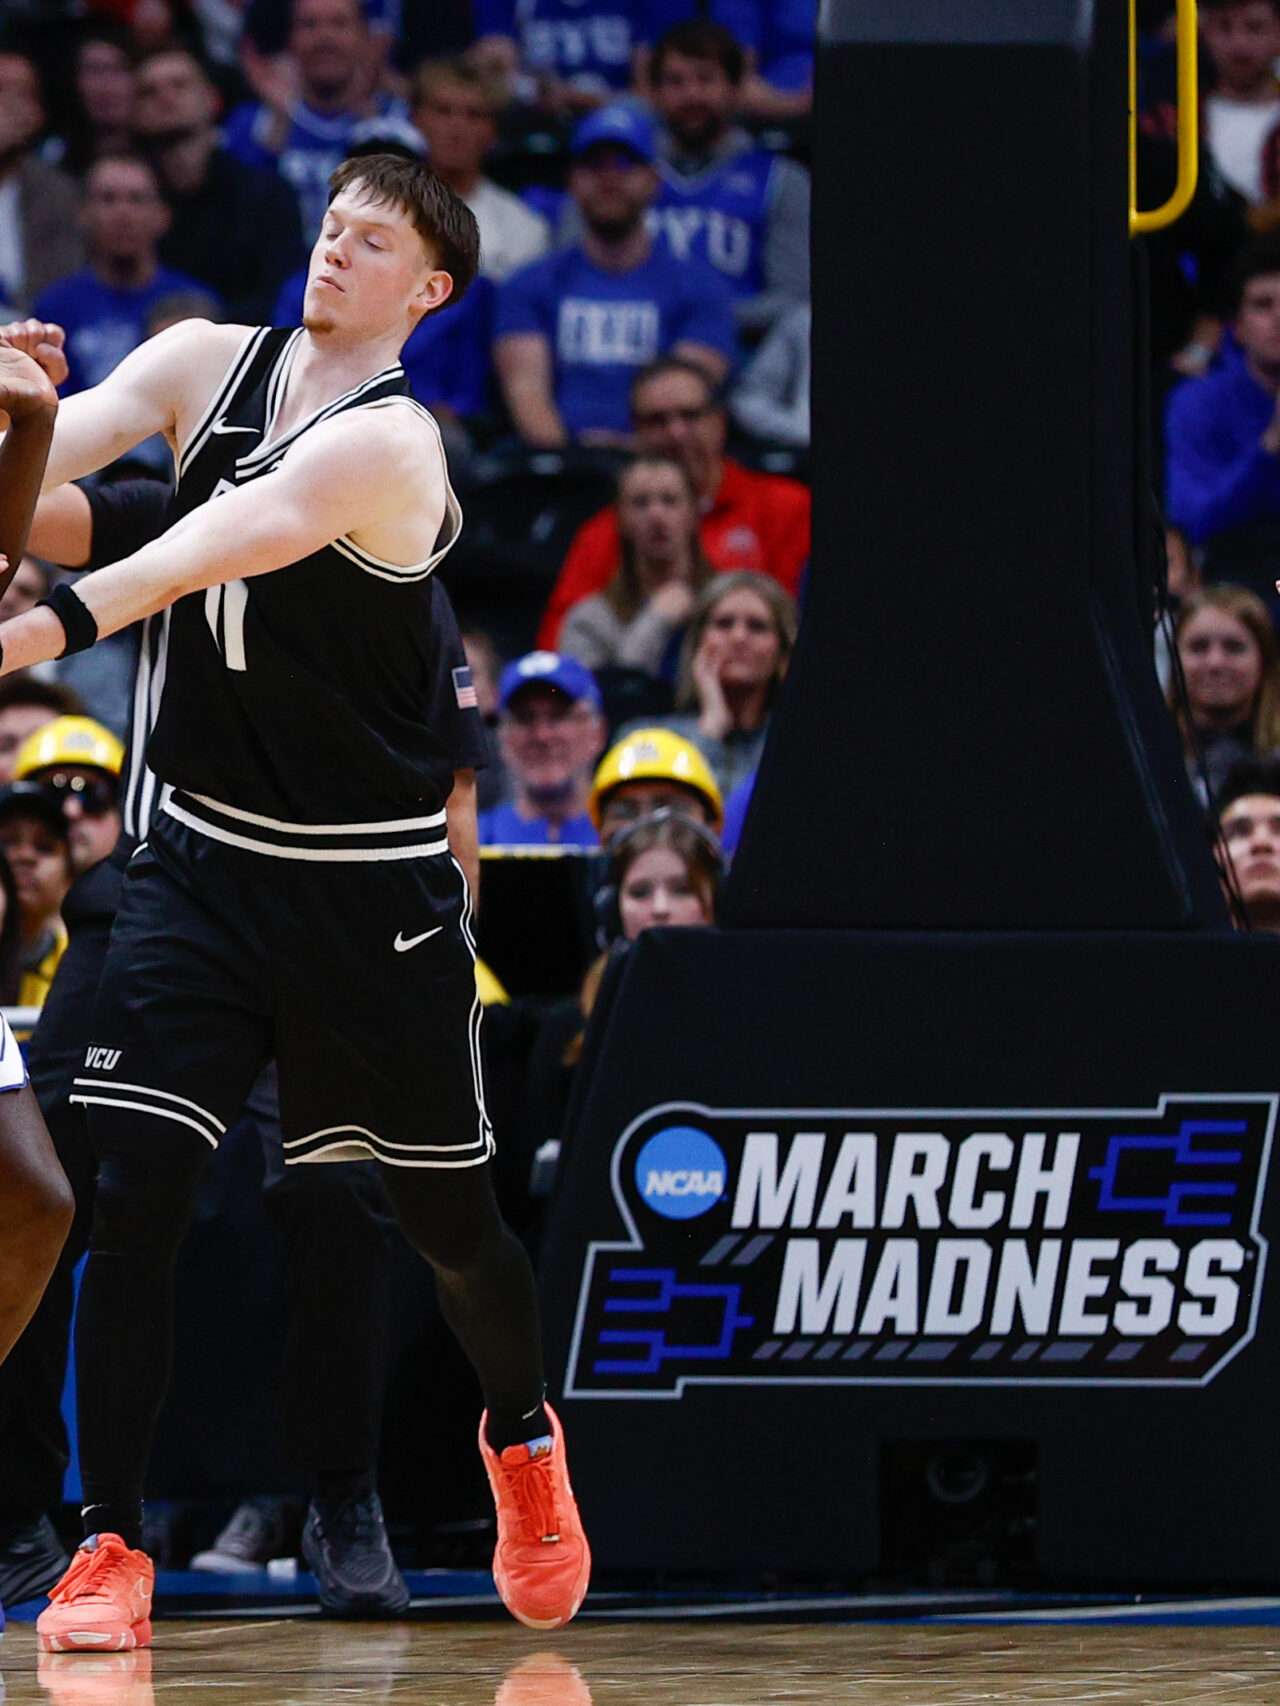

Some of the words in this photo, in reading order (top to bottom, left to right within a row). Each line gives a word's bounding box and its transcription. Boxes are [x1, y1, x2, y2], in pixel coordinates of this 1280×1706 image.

[644, 207, 751, 277] YU
[84, 1046, 123, 1070] VCU
[645, 1168, 724, 1197] NCAA
[730, 1132, 1081, 1230] MARCH
[772, 1238, 1246, 1336] MADNESS
